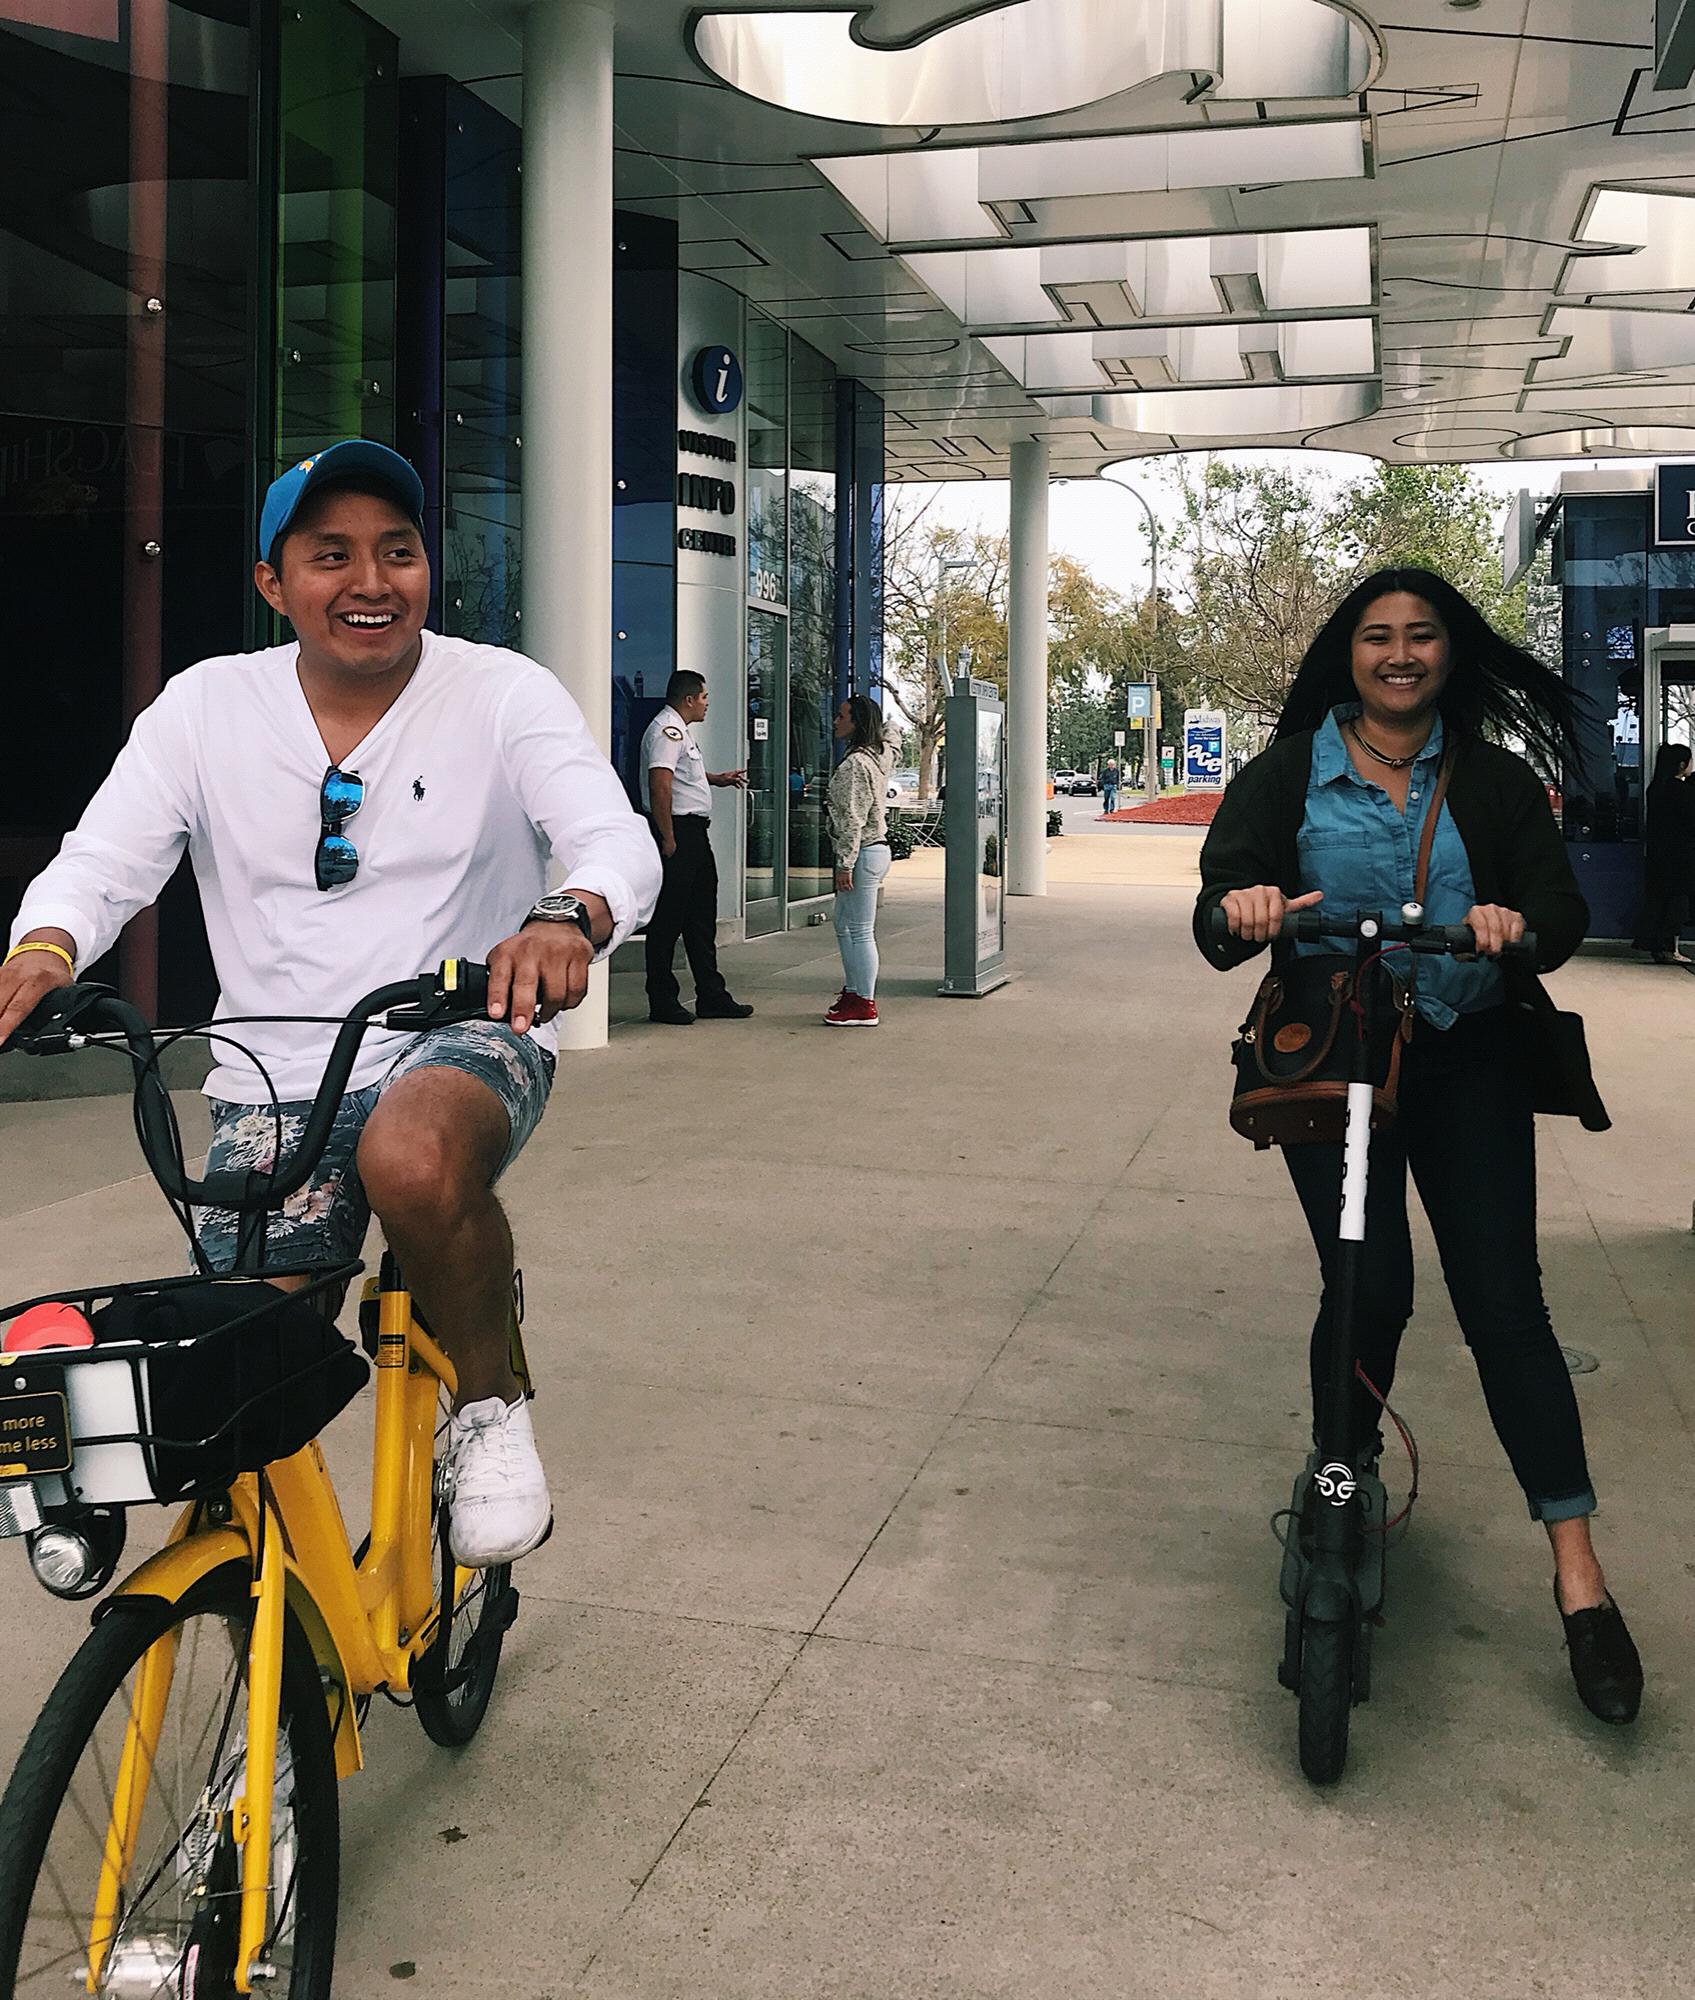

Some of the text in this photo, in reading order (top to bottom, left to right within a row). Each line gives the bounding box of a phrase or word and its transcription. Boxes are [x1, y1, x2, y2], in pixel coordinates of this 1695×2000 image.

[678, 473, 736, 515] INFO
[678, 528, 737, 557] CENTER
[756, 567, 777, 602] 996
[1132, 696, 1146, 714] P
[1187, 743, 1222, 772] ace
[1188, 775, 1222, 785] parking
[2, 1414, 47, 1432] more
[24, 1434, 58, 1452] less
